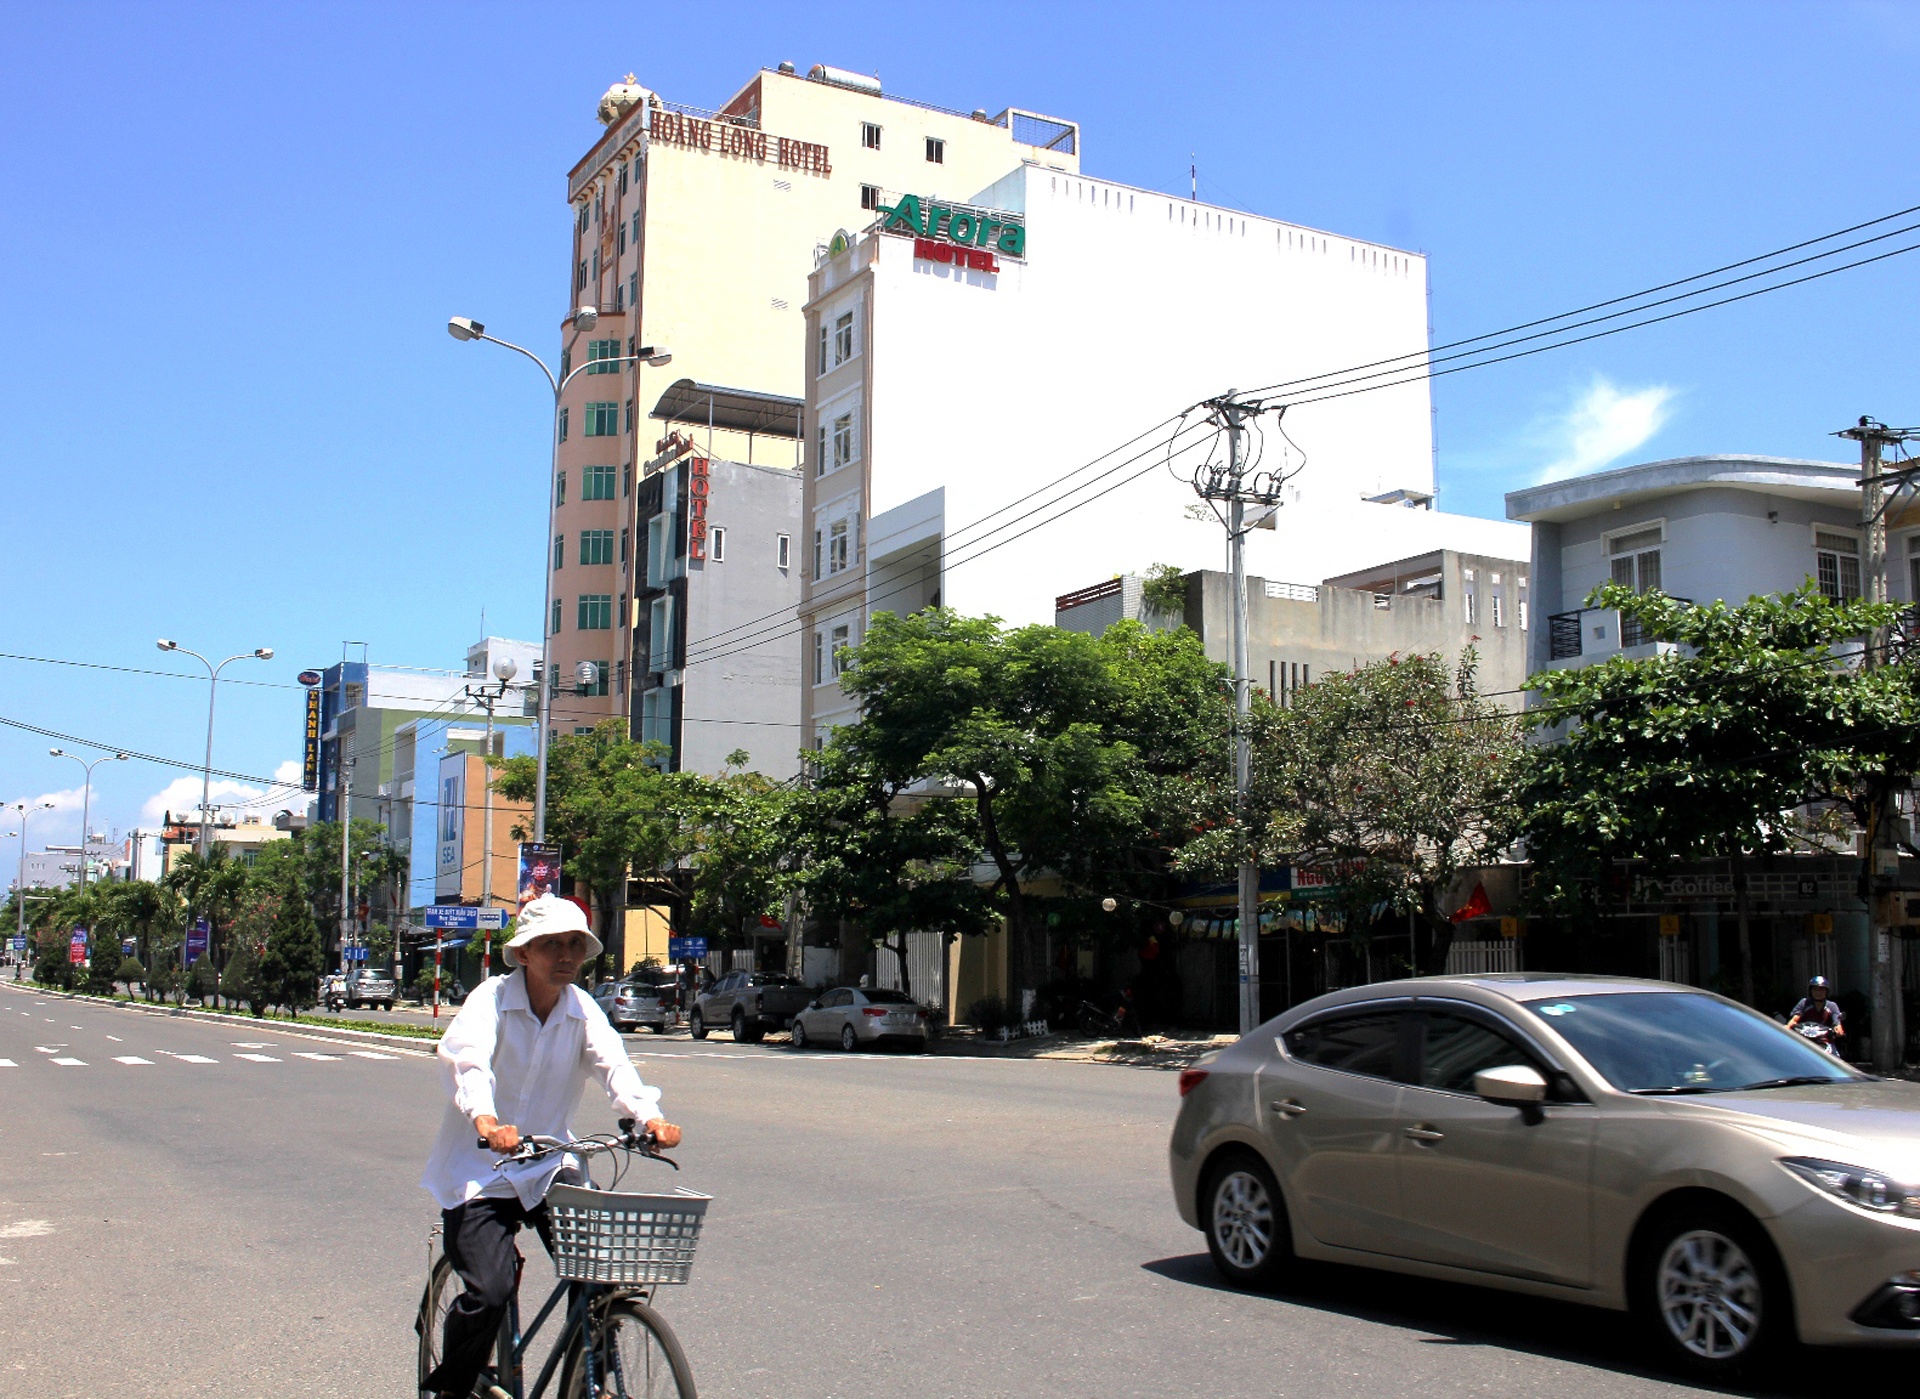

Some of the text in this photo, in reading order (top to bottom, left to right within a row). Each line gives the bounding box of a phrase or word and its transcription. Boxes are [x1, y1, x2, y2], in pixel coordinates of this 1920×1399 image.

[720, 124, 767, 161] LONG
[778, 137, 832, 173] HOTEL
[876, 194, 1025, 254] Arora
[914, 238, 1000, 273] HOTEL
[691, 457, 710, 560] HOTEL
[307, 691, 318, 738] THANH
[306, 743, 315, 771] LAN
[443, 846, 454, 864] SEA
[1671, 879, 1736, 895] Coffee
